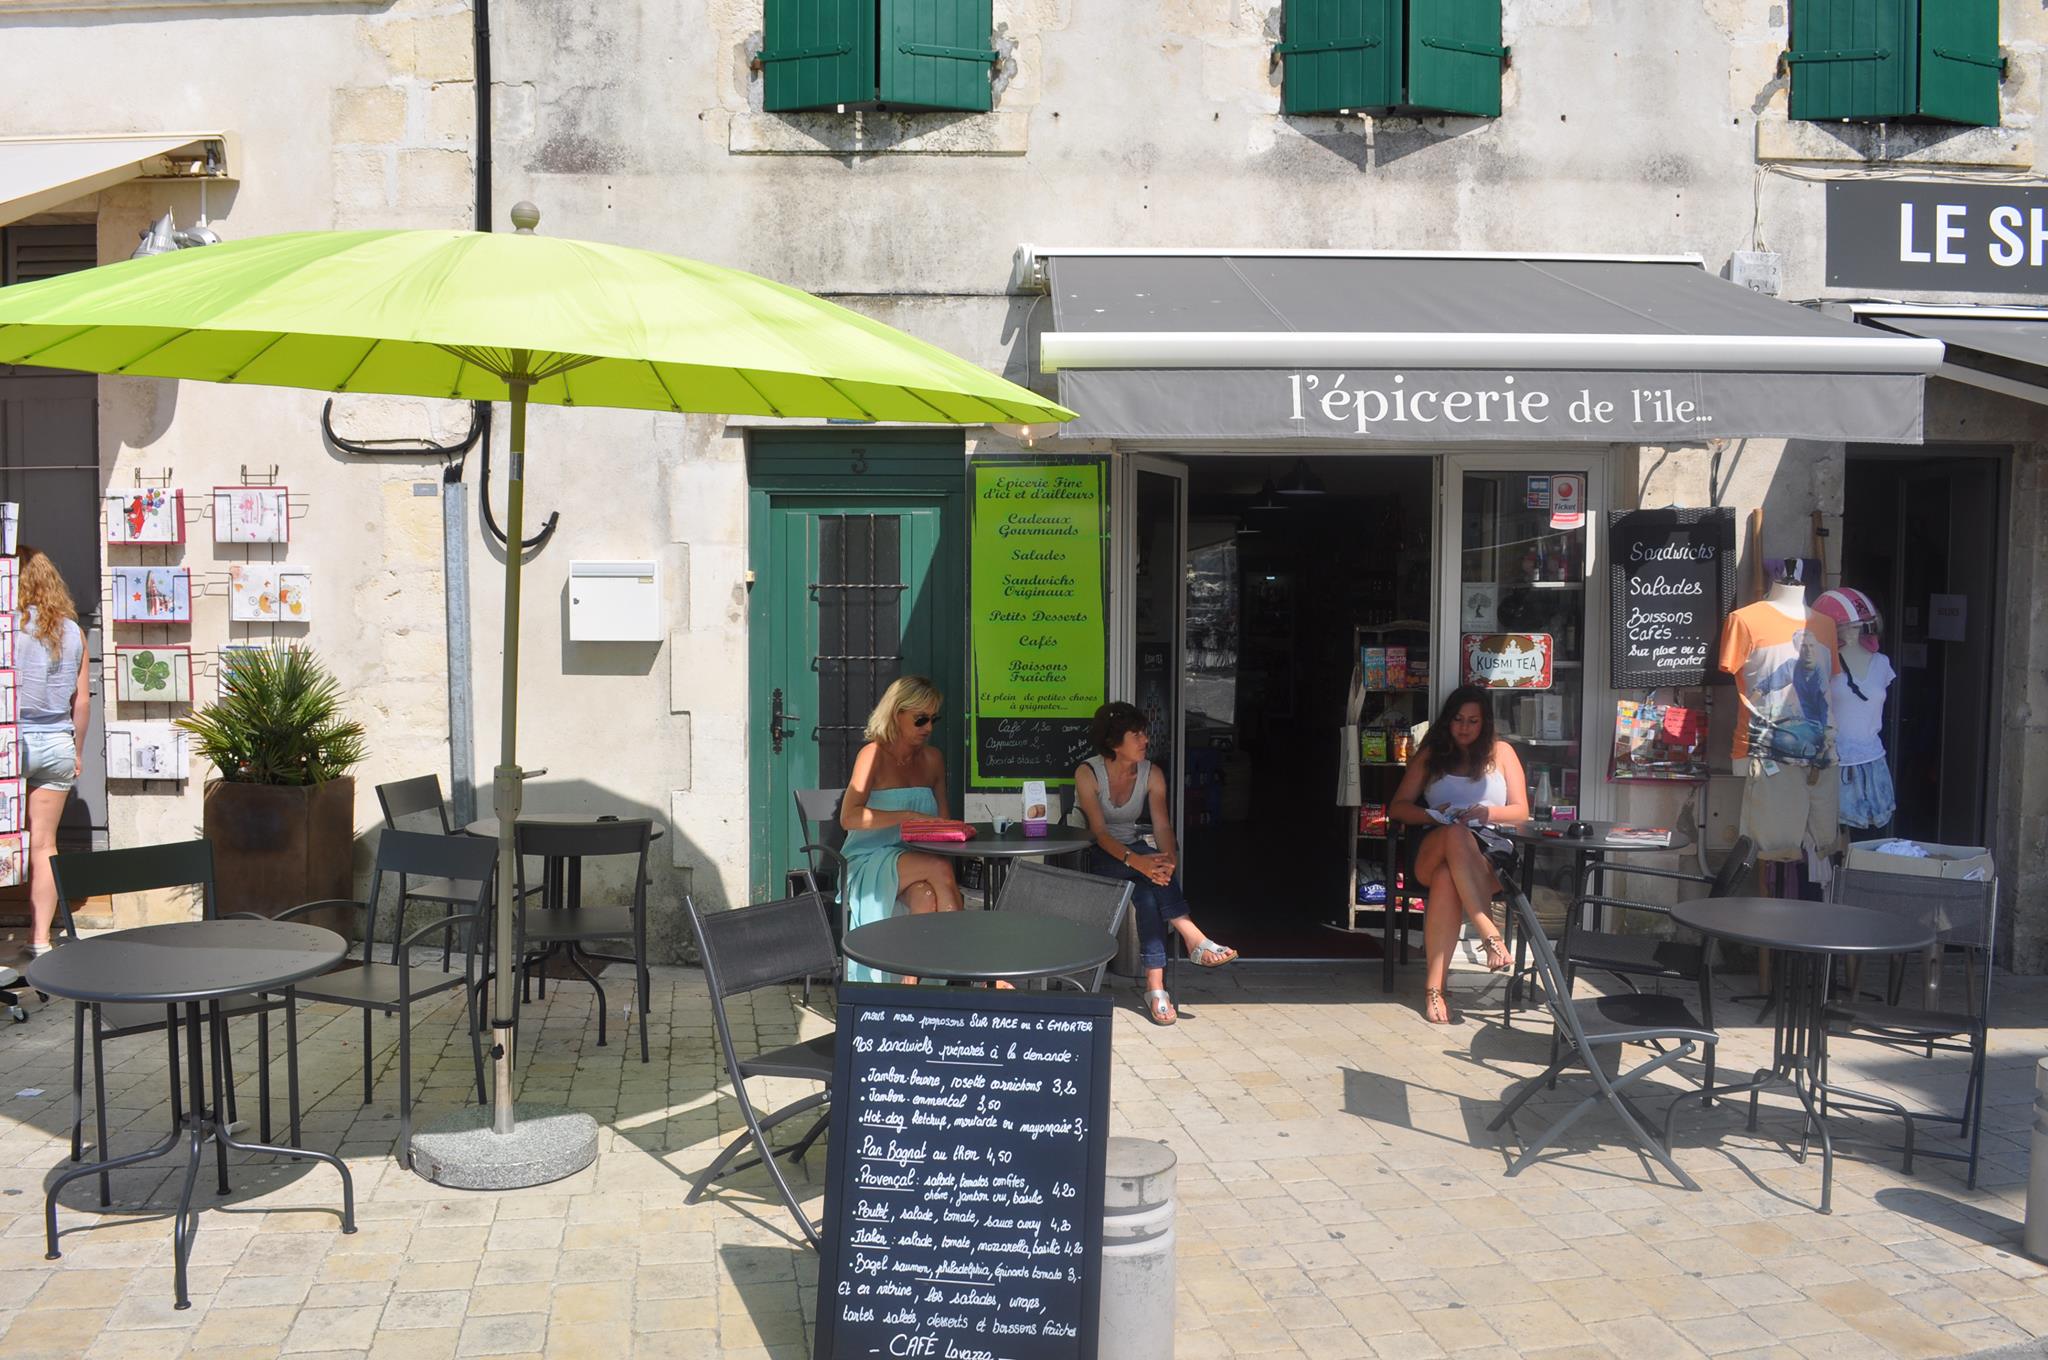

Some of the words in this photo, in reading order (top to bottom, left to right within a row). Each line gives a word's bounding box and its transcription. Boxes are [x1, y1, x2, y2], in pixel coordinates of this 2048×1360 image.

[1900, 202, 1967, 264] LE
[1287, 372, 1549, 434] l'épicerie
[1568, 389, 1615, 423] de
[851, 448, 868, 474] 3
[996, 477, 1048, 491] Epicerie
[1054, 476, 1083, 488] Fine
[983, 488, 1009, 500] d'ici
[1015, 489, 1026, 500] et
[1031, 488, 1094, 500] d'ailleurs
[1554, 503, 1576, 511] Ticket
[1008, 513, 1071, 525] Cadeaux
[999, 524, 1079, 538] Gourmands
[1011, 549, 1066, 561] Salades
[1630, 542, 1716, 561] Sandwichs
[1002, 574, 1075, 586] Sandwichs
[1630, 575, 1703, 596] Salades
[1004, 585, 1074, 600] Originaux
[989, 610, 1027, 622] Petits
[1032, 610, 1088, 622] Desserts
[1627, 606, 1693, 628] Boissons
[1019, 634, 1058, 649] Cafés
[1628, 644, 1650, 657] Sur
[1652, 645, 1678, 660] place
[1681, 645, 1694, 654] ou
[1698, 642, 1708, 654] à
[1008, 660, 1068, 672] Boissons
[1476, 655, 1512, 672] KUSMI
[1517, 656, 1537, 671] TEA
[1657, 657, 1706, 669] emporter
[1010, 671, 1067, 683] Fraîches
[981, 693, 991, 701] Et
[993, 693, 1016, 703] plein
[1024, 693, 1034, 701] de
[1037, 693, 1066, 703] petites
[1069, 693, 1098, 701] choses
[998, 718, 1025, 739] Café
[969, 1013, 988, 1027] SUR
[991, 1016, 1019, 1029] PLACE
[1020, 1021, 1031, 1030] ou
[1047, 1019, 1094, 1032] EMPORTER
[989, 1044, 1000, 1060] à
[1006, 1041, 1018, 1060] la
[950, 1074, 986, 1089] rosette
[990, 1076, 1043, 1093] cornichons
[1052, 1078, 1078, 1096] 3,20
[863, 1108, 905, 1133] Hot-dog
[953, 1114, 998, 1128] moutarde
[1002, 1119, 1014, 1130] ou
[1019, 1118, 1072, 1140] mayonnaise
[862, 1134, 883, 1157] Pan
[886, 1139, 927, 1168] Bagnat
[932, 1149, 948, 1161] au
[952, 1144, 980, 1161] thon
[986, 1147, 1013, 1167] 4,50
[955, 1189, 989, 1207] jambon
[1012, 1189, 1044, 1205] basilic
[1052, 1181, 1076, 1198] 4,20
[983, 1215, 1014, 1228] sauce
[1016, 1219, 1041, 1238] curry
[1032, 1237, 1061, 1255] basilic
[1063, 1241, 1084, 1257] 4,20
[854, 1252, 889, 1277] Bagel
[837, 1280, 851, 1296] Et
[857, 1283, 871, 1295] en
[842, 1304, 875, 1323] tartes
[926, 1312, 969, 1329] desserts
[975, 1316, 987, 1333] et
[992, 1317, 1038, 1335] boissons
[1042, 1319, 1077, 1337] fraîches
[889, 1331, 939, 1357] CAFÉ
[944, 1338, 994, 1360] Lavazza
